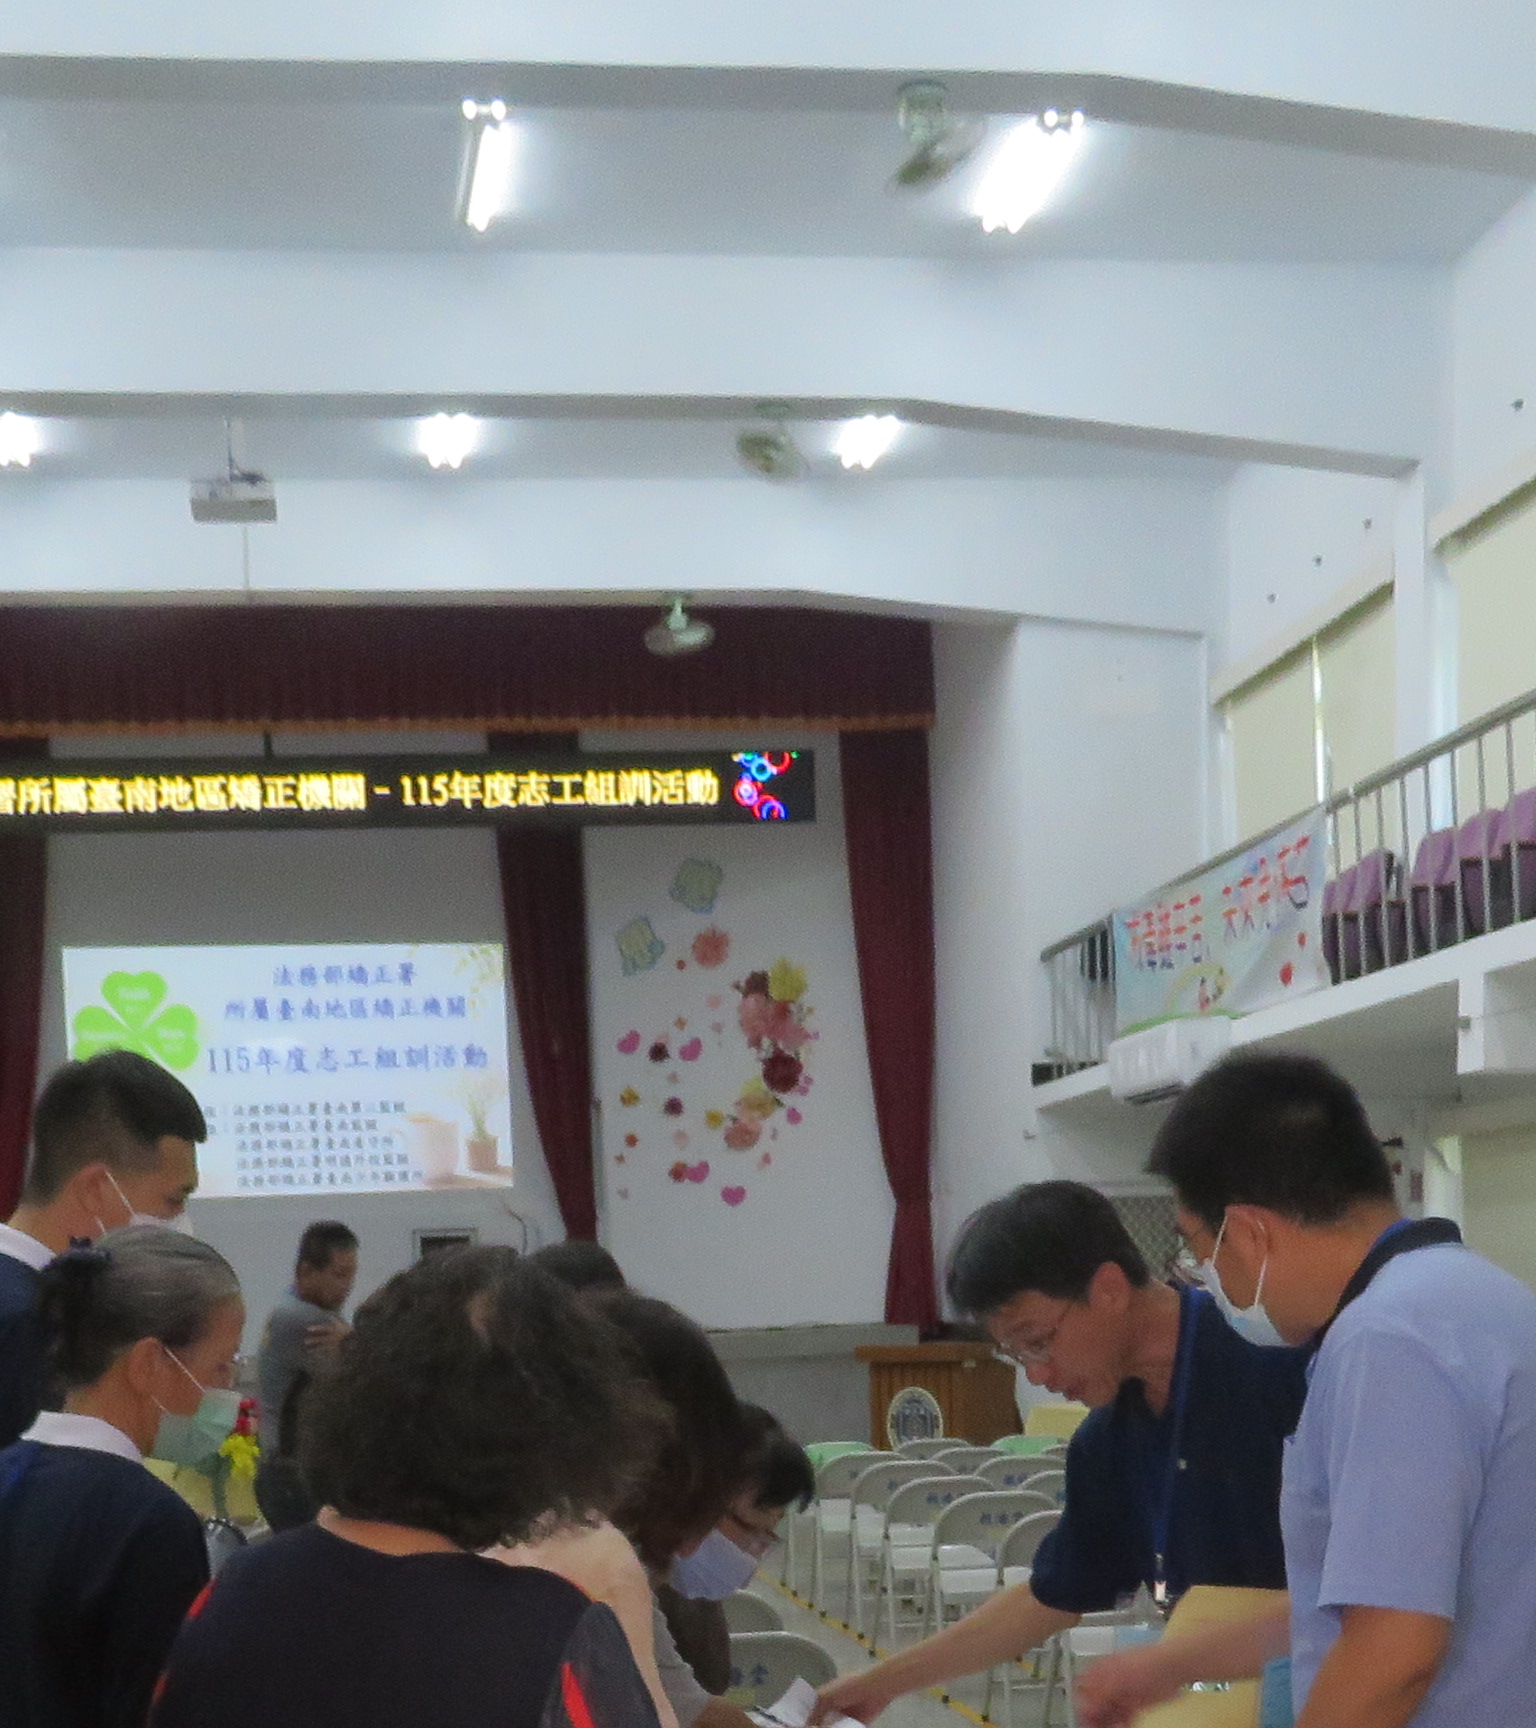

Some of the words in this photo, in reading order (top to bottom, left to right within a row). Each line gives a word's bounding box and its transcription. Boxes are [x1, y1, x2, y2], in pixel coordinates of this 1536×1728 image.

[399, 769, 720, 809] 115年度志工組訓活動
[207, 1043, 489, 1075] 115年度志工組訓活動
